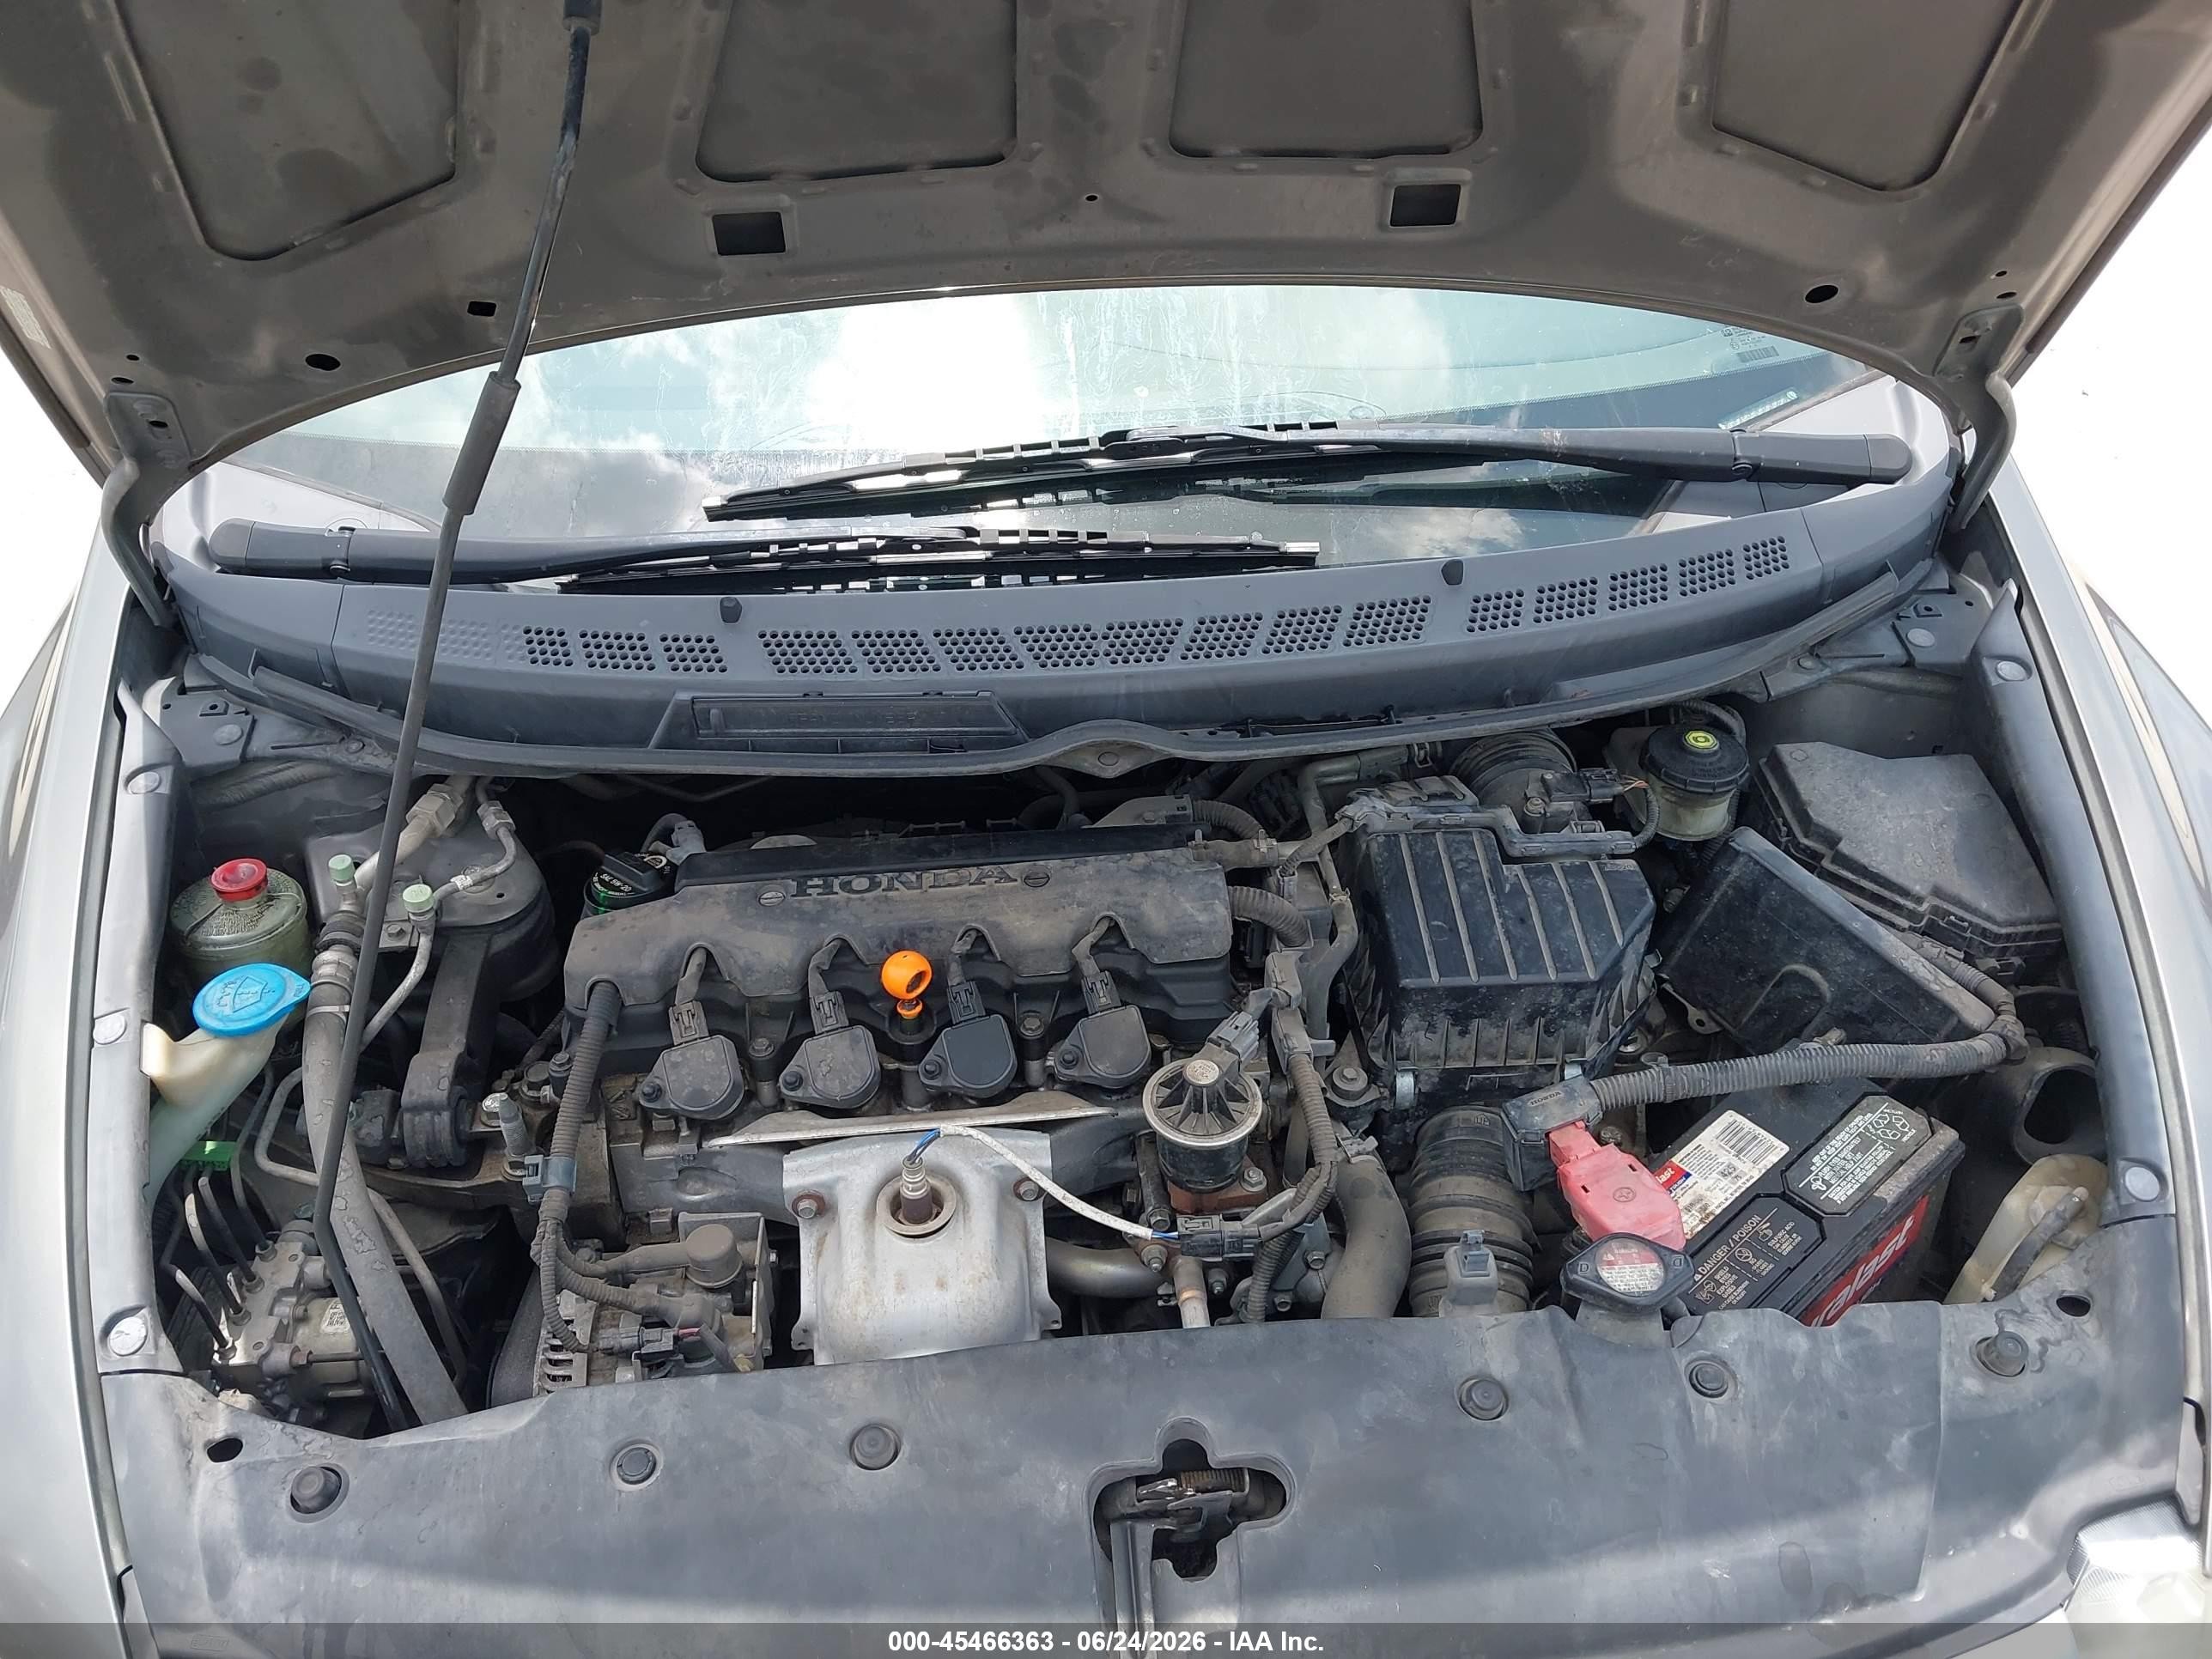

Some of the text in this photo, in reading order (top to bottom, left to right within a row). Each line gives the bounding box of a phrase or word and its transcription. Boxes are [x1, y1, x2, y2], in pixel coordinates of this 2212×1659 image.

[599, 873, 612, 883] SAE
[611, 879, 633, 892] 5W-20
[790, 866, 1018, 897] HONDA
[1529, 1091, 1562, 1106] HONDA
[1698, 1244, 1730, 1273] DANGER
[1729, 1238, 1735, 1248] /
[1732, 1213, 1762, 1241] POISON
[1713, 1266, 1729, 1279] SHIELD
[1718, 1272, 1731, 1283] EYES
